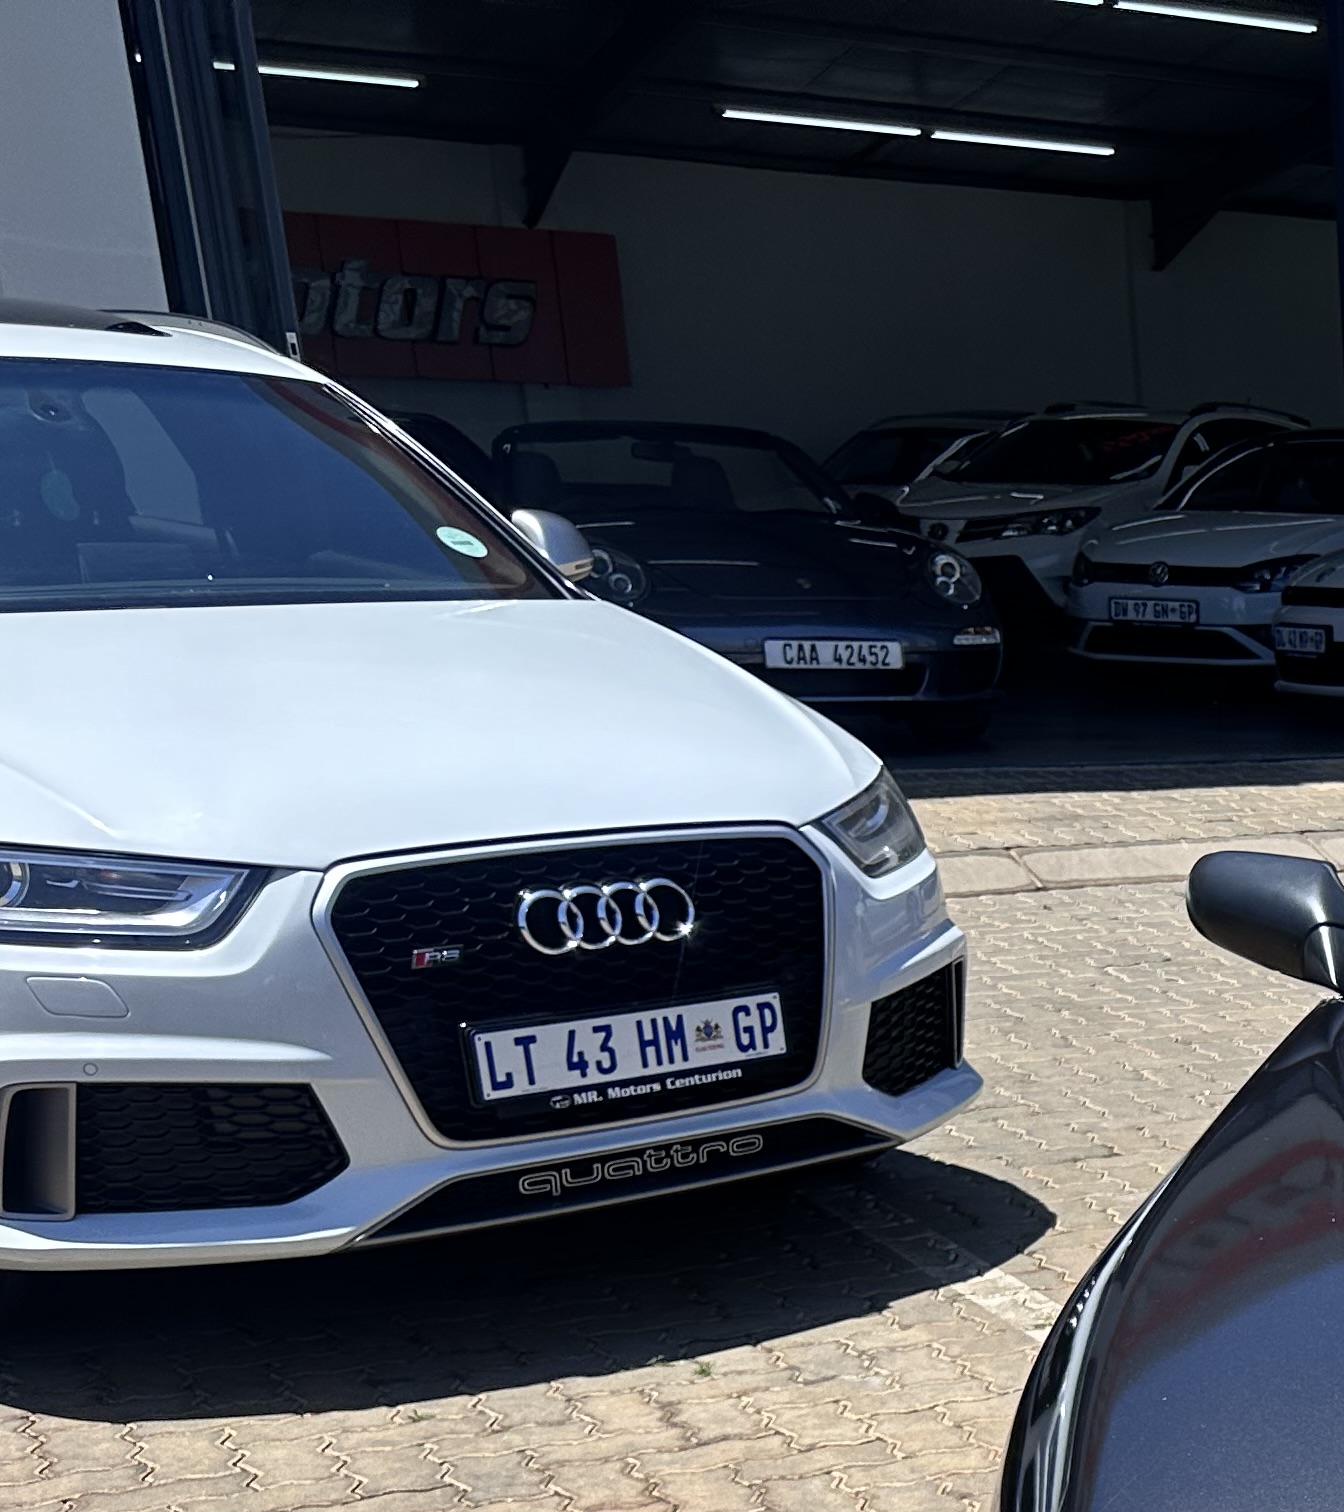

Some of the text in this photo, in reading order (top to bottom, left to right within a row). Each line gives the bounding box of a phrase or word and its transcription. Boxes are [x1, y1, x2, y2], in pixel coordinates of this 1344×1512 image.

[783, 643, 890, 667] CAA 42452
[484, 1001, 778, 1091] LT 43 HM GP
[573, 1067, 742, 1106] MR. Motors Centurion
[519, 1134, 763, 1196] quattro
